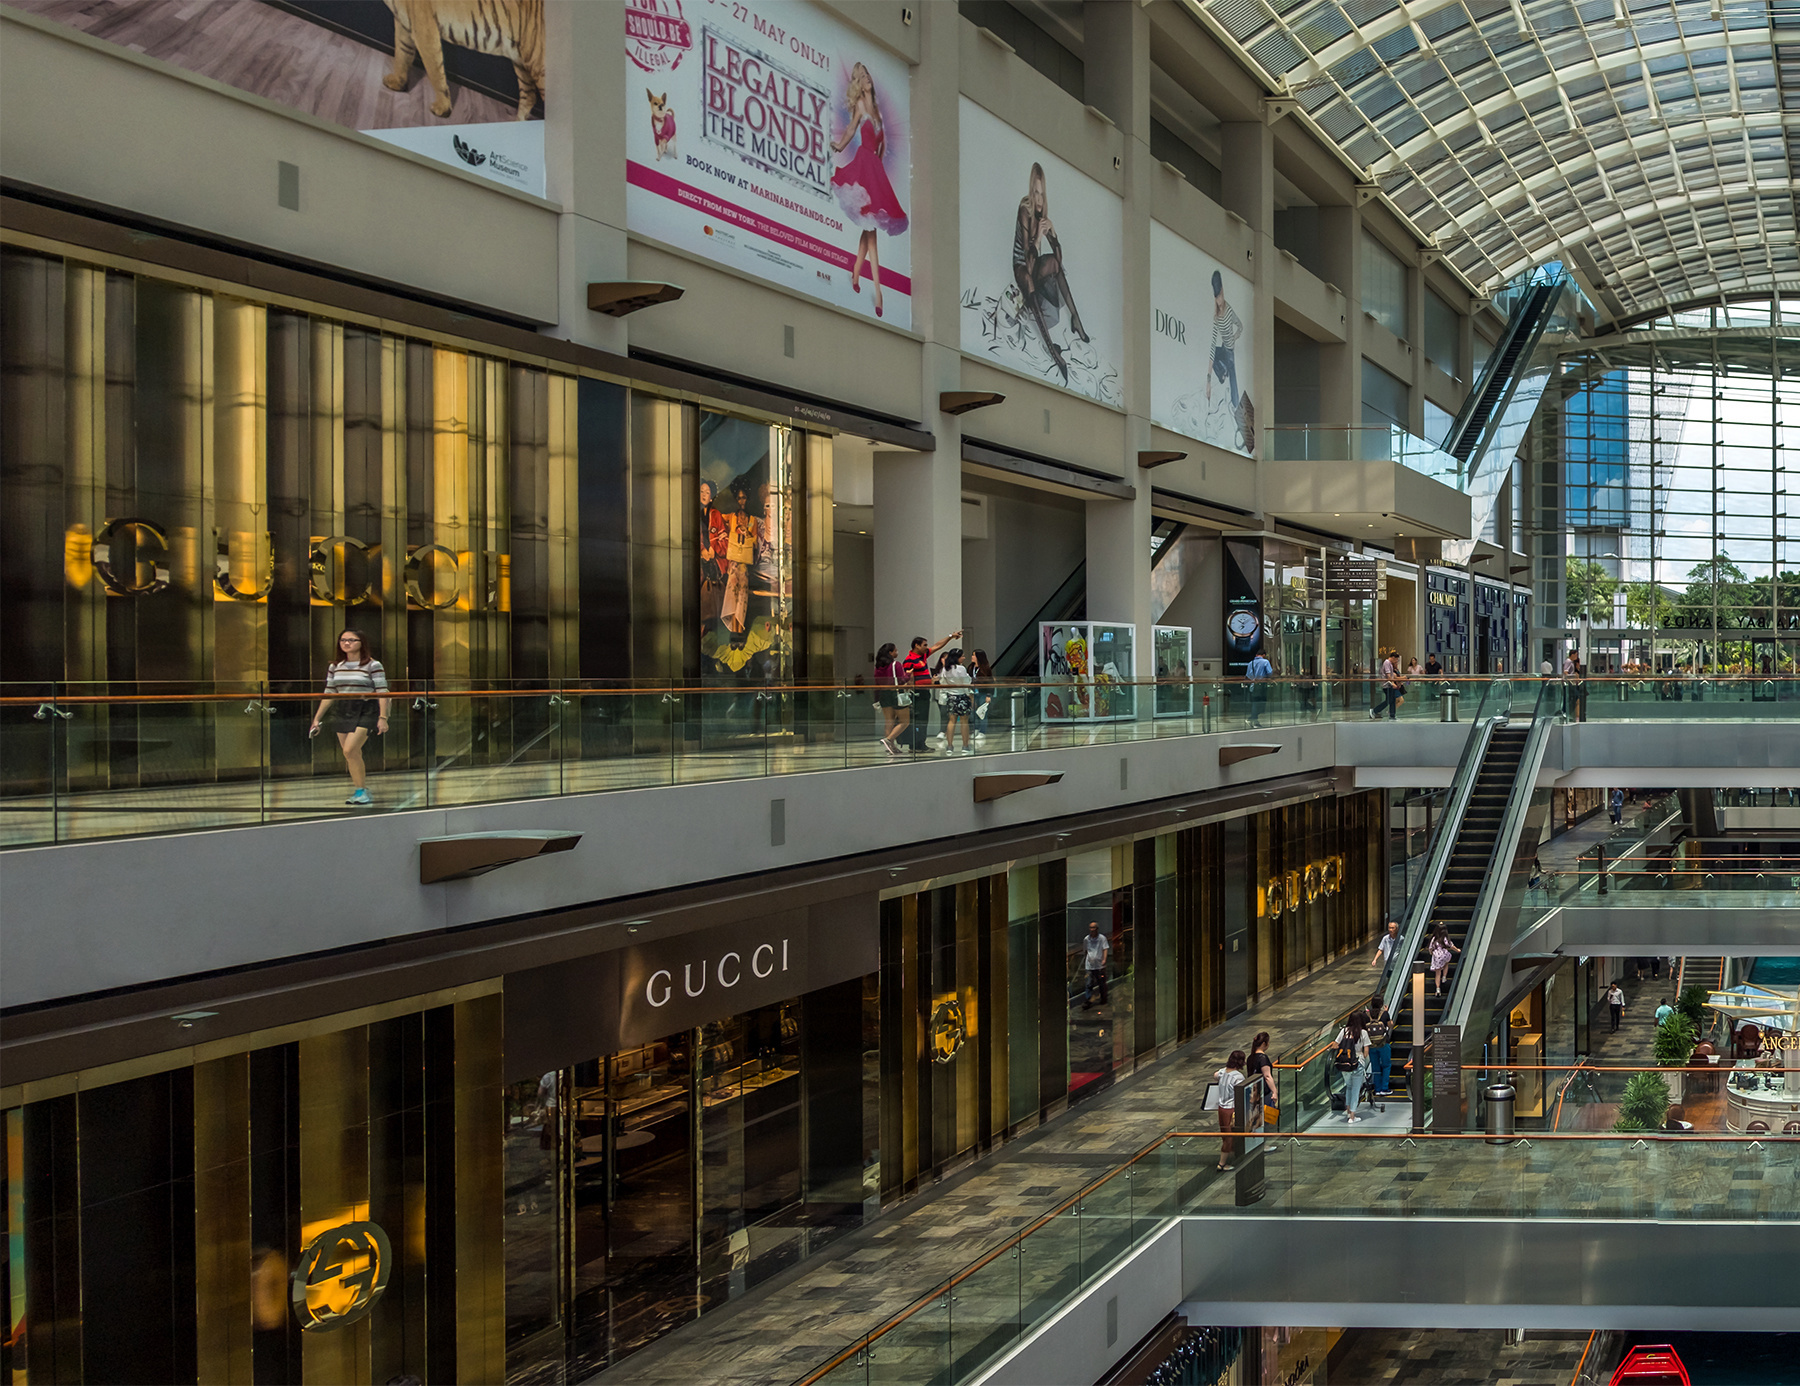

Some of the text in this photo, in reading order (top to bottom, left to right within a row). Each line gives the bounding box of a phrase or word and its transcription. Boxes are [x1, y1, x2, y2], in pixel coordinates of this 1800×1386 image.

[627, 14, 682, 43] SHOULD BE
[635, 45, 671, 66] ILLEGAL
[732, 1, 830, 72] 27 MAY ONLY!
[706, 34, 827, 129] LEGALLY
[707, 72, 826, 165] BLONDE
[707, 111, 826, 187] THE MUSICAL
[489, 150, 529, 173] ArtScience
[489, 158, 521, 178] Museum
[686, 154, 844, 232] BOOK NOW AT MARINABAYSANDS.COM
[677, 188, 703, 205] DIRECT
[703, 197, 723, 212] FROM
[723, 206, 737, 219] NEW
[757, 221, 770, 233] THE
[769, 225, 795, 243] BELOVED
[794, 236, 809, 249] FILM
[1155, 308, 1187, 345] DIOR
[91, 517, 499, 612] GUCCI
[1429, 591, 1457, 607] CHAUMET
[646, 938, 789, 1008] GUCCI
